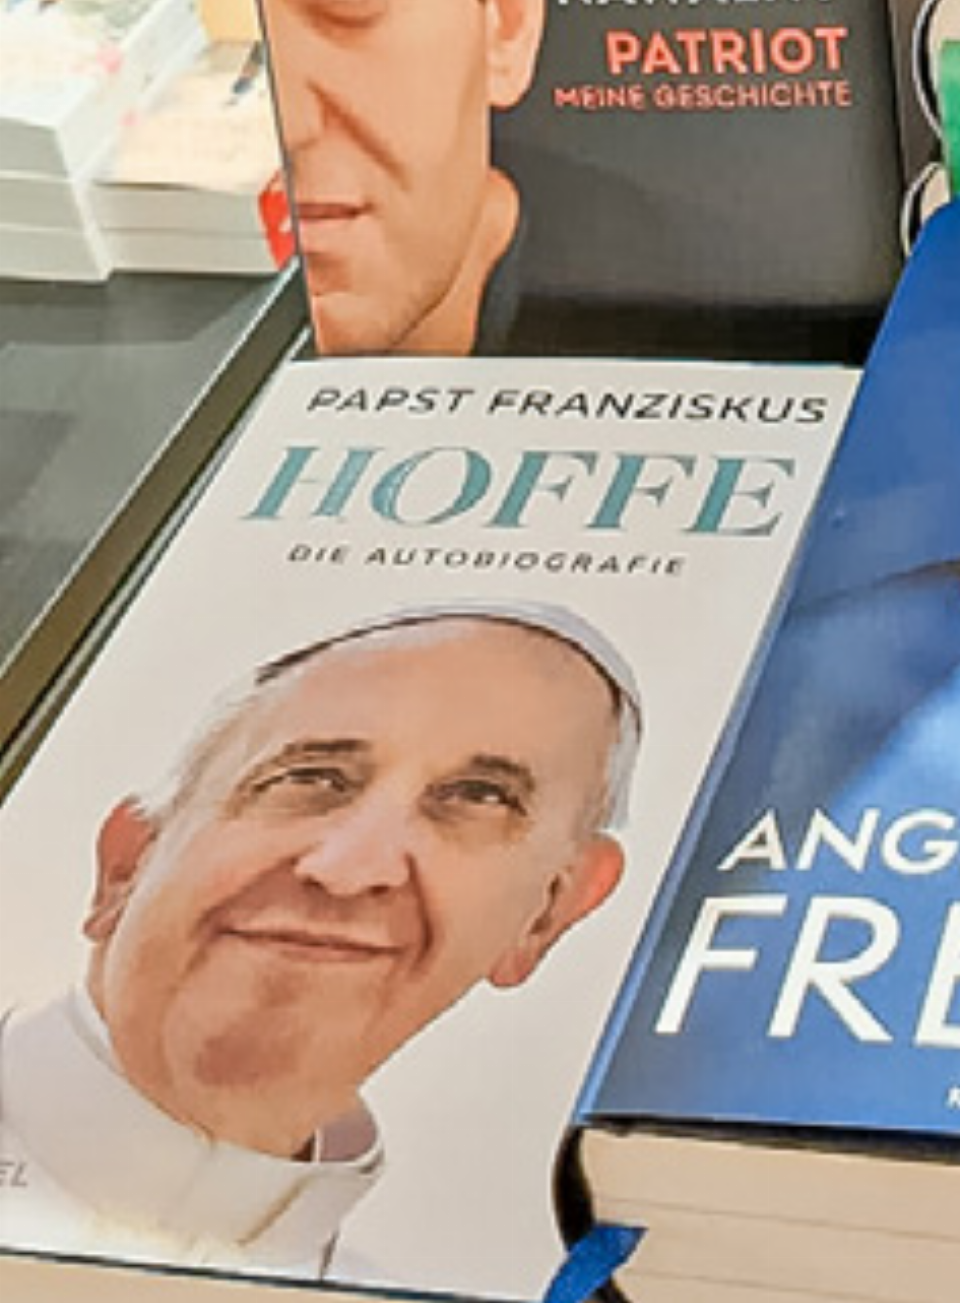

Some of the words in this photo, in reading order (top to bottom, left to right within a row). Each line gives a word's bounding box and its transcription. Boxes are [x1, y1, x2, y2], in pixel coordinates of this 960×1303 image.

[605, 26, 848, 75] PATRIOT
[554, 83, 646, 111] MEINE
[654, 79, 852, 109] GESCHICHTE
[306, 388, 476, 414] PAPST
[488, 389, 829, 424] FRANZISKUS
[239, 445, 796, 537] HOFFE
[286, 543, 349, 564] DIE
[365, 547, 688, 577] AUTOBIOGRAFIE
